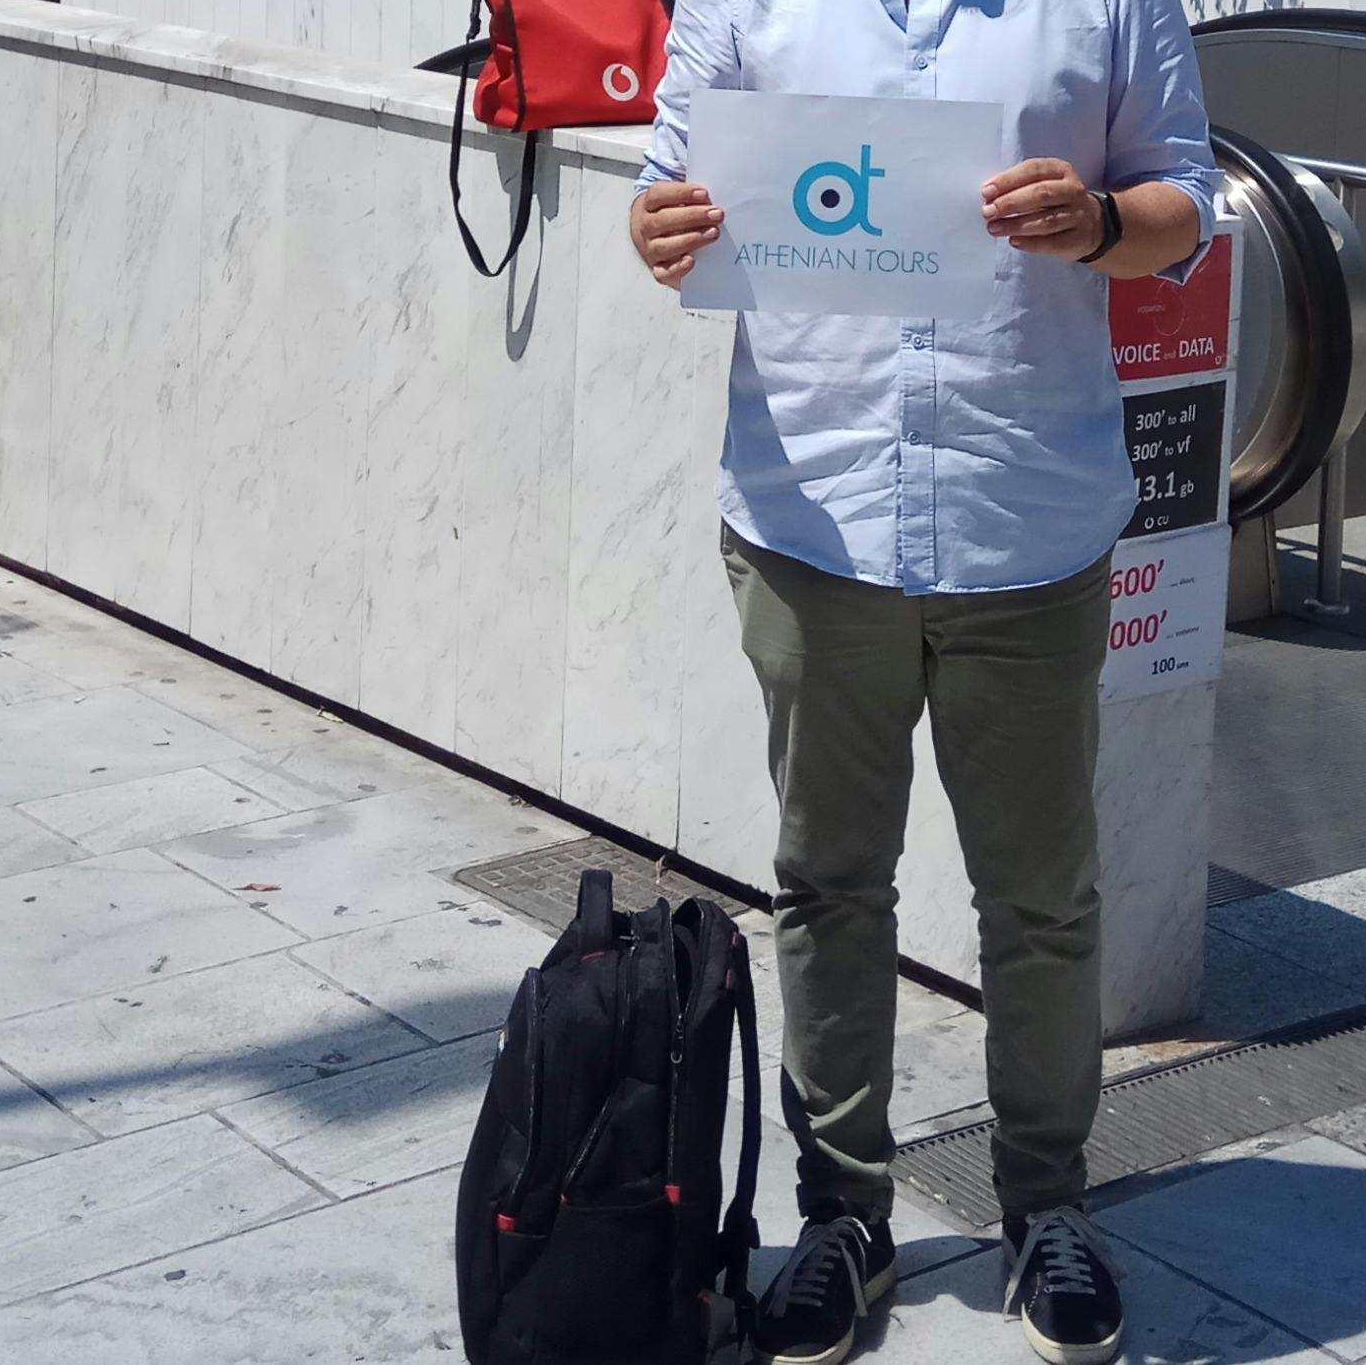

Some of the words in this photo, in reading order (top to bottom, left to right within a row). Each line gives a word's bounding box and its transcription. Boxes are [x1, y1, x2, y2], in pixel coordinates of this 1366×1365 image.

[735, 243, 856, 270] ATHENIAN
[865, 249, 939, 275] TOURS
[1112, 343, 1161, 365] VOICE
[1178, 337, 1214, 358] DATA
[1135, 410, 1166, 431] 300'
[1180, 404, 1196, 423] all
[1177, 435, 1191, 454] vf
[1180, 479, 1195, 498] gb
[1151, 657, 1176, 676] 100
